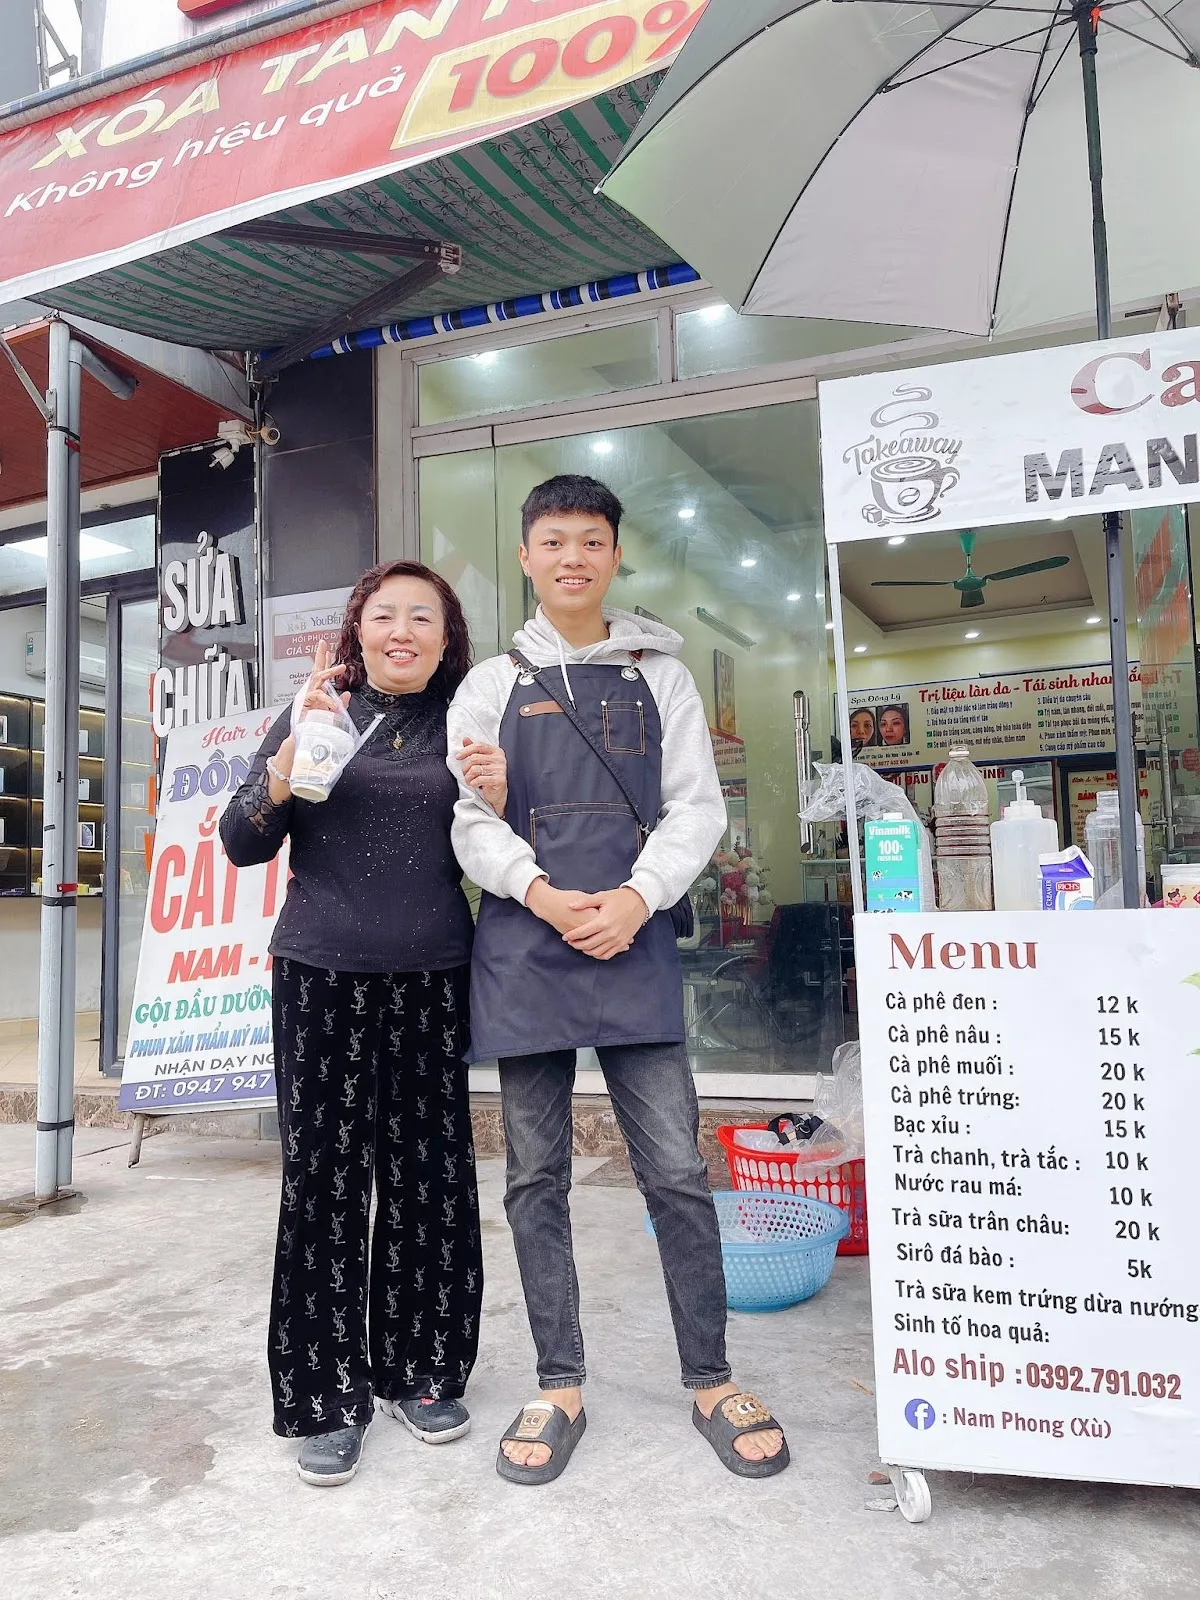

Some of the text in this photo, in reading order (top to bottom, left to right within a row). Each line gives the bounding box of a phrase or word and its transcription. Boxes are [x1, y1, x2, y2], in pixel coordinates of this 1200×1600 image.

[28, 0, 463, 172] XÓA TAN
[3, 64, 407, 218] Không hiệu quả
[843, 433, 963, 476] Takeaway
[164, 531, 241, 631] SỬA
[286, 647, 303, 656] GIÁ
[153, 643, 250, 737] CHỮA
[919, 689, 940, 703] Trị
[942, 685, 966, 702] liệu
[968, 683, 990, 699] làn
[993, 680, 1011, 696] da
[1022, 677, 1047, 692] Tái
[1048, 674, 1079, 690] sinh
[202, 726, 247, 749] Hair
[868, 825, 911, 836] Vinamilk
[167, 943, 243, 984] NAM
[889, 933, 1037, 969] Menu
[135, 997, 170, 1029] GỘI
[175, 988, 217, 1020] ĐẦU
[886, 992, 1138, 1013] Cà phê đen 12 k
[129, 1037, 164, 1058] PHUN
[889, 1024, 1139, 1046] Cà phê nâu 15 k
[155, 1060, 205, 1076] NHẬN
[210, 1056, 247, 1071] DẠY
[890, 1055, 1144, 1081] Cà phê muối 20 k
[135, 1073, 271, 1100] ĐT: 0947 947
[892, 1085, 1144, 1110] Cà phê trứng: 20 k
[895, 1115, 1145, 1138] Bạc xỉu 15 k
[893, 1144, 1148, 1170] Trà chanh, trà tắc 10 k
[896, 1173, 1152, 1206] Nước rau má: 10 k
[892, 1207, 1159, 1240] Trà sữa trân châu: 20 k
[897, 1243, 1152, 1278] Sirô đá bào 5k
[895, 1279, 1198, 1322] Trà sữa kem trứng dừa nướng
[895, 1313, 1049, 1343] Sinh tố hoa quả:
[894, 1348, 935, 1376] Alo
[945, 1353, 1004, 1387] ship
[954, 1407, 1111, 1438] Nam Phong (Xù)
